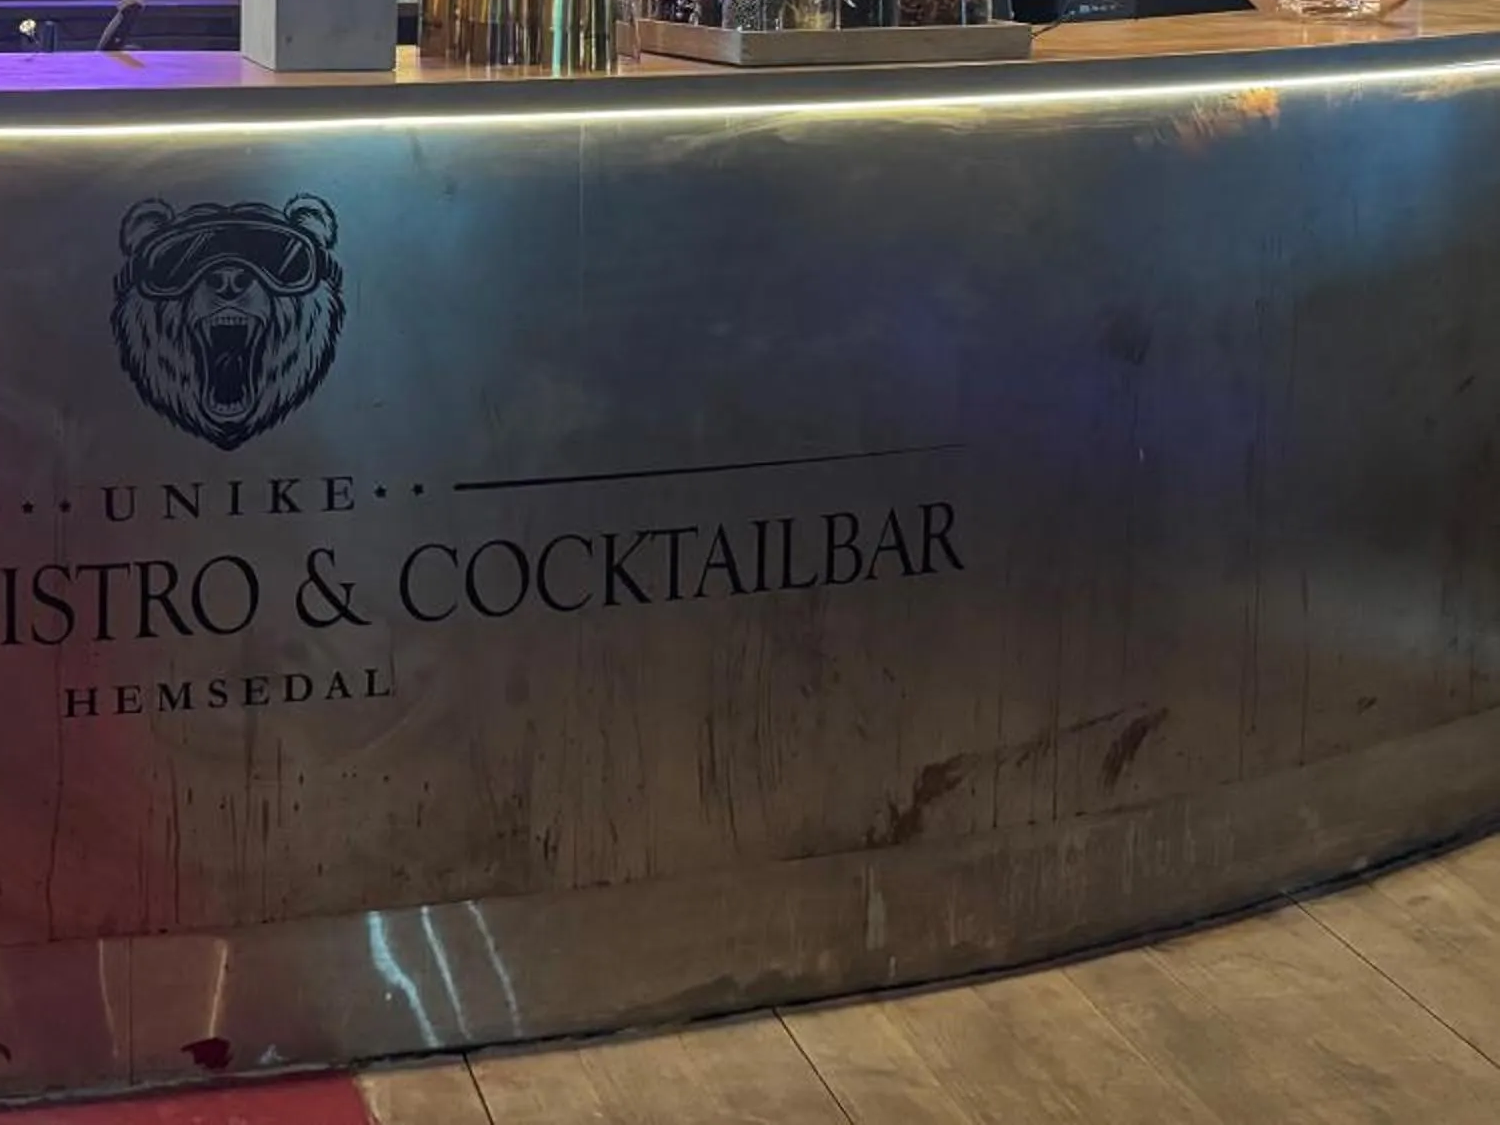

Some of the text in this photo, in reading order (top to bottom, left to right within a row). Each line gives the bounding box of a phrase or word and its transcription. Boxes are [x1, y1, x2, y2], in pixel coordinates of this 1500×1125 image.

[101, 476, 357, 523] UNIKE
[296, 547, 373, 628] &
[399, 501, 965, 623] COCKTAILBAR
[64, 668, 391, 719] HEMSEDAL
